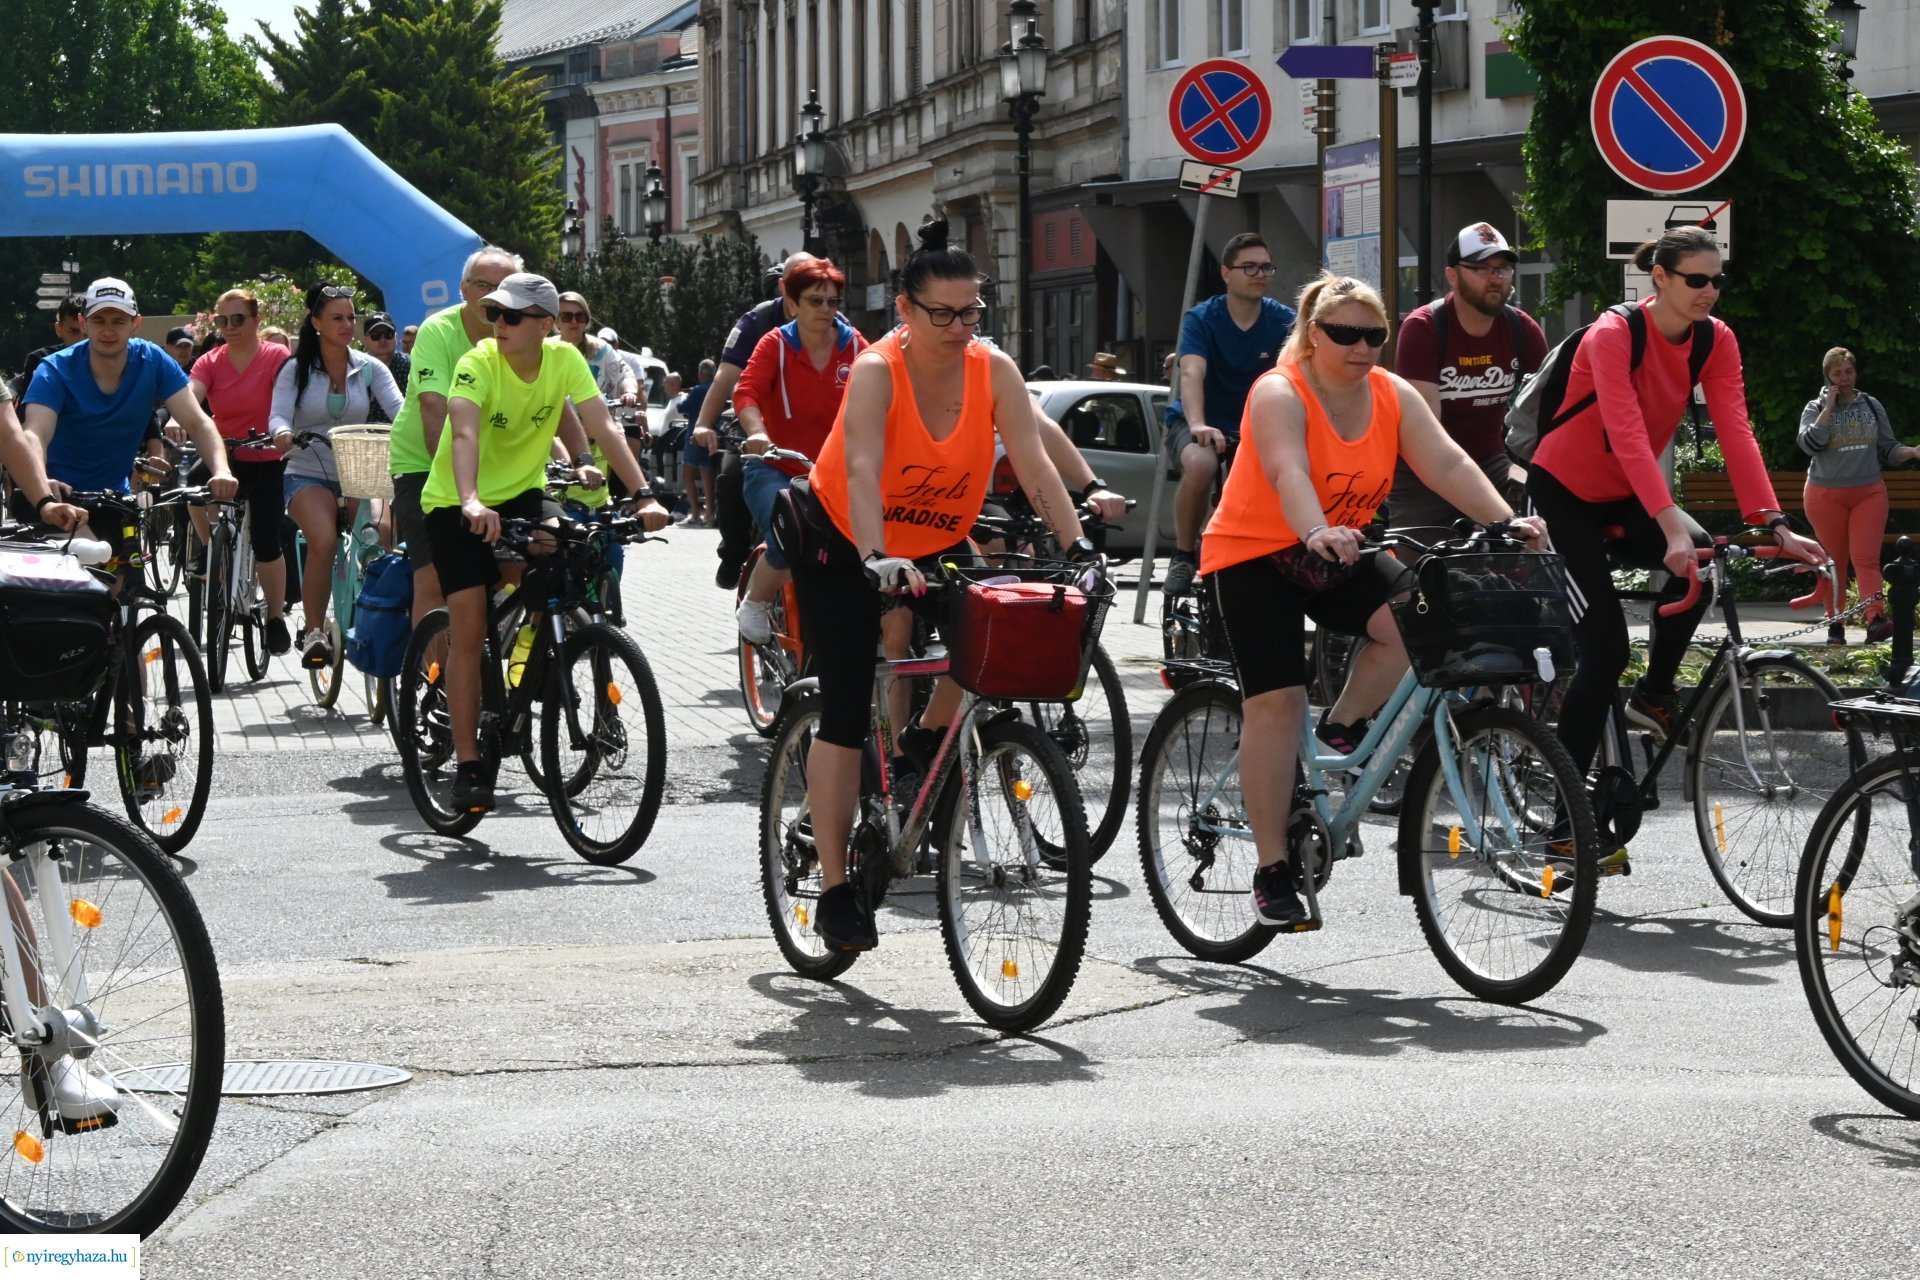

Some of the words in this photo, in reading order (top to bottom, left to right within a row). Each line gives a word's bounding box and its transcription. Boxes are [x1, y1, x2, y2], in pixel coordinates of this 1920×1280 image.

[23, 160, 257, 198] SHIMANO
[887, 465, 970, 500] Feels
[59, 646, 87, 661] KLS
[1369, 698, 1416, 773] GALAXY
